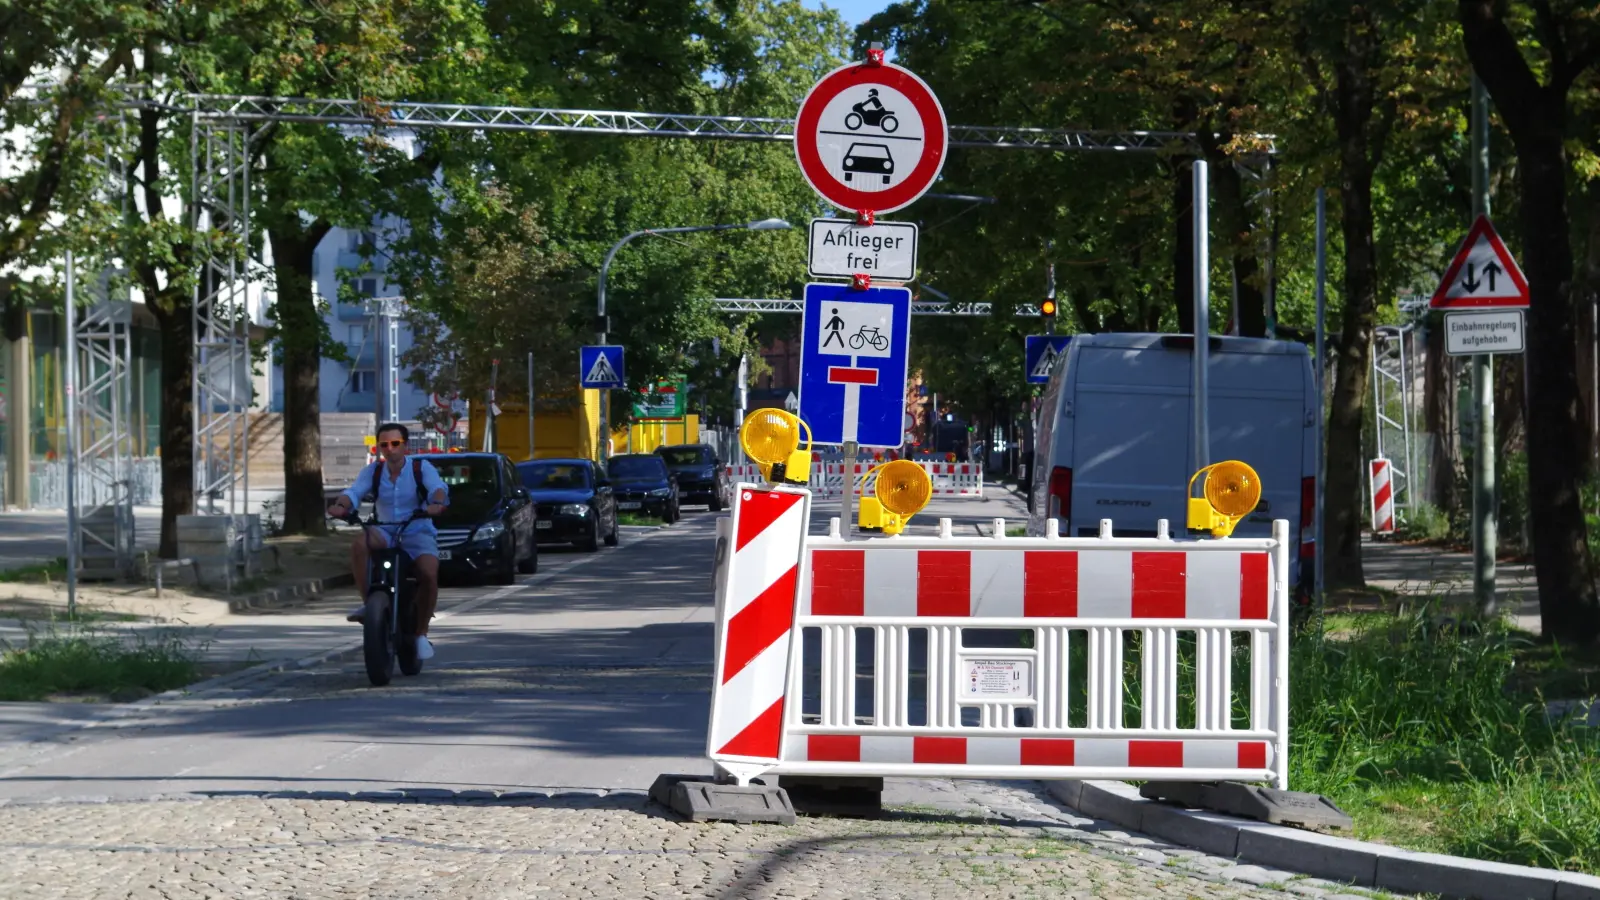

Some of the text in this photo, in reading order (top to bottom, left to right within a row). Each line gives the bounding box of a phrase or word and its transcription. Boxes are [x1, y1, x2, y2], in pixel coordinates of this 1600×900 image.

[823, 229, 904, 252] Anlieger
[847, 252, 879, 270] frei
[1451, 320, 1517, 333] Einbahnregelung
[1462, 334, 1508, 347] aufgehoben
[1096, 499, 1152, 507] DUCATO
